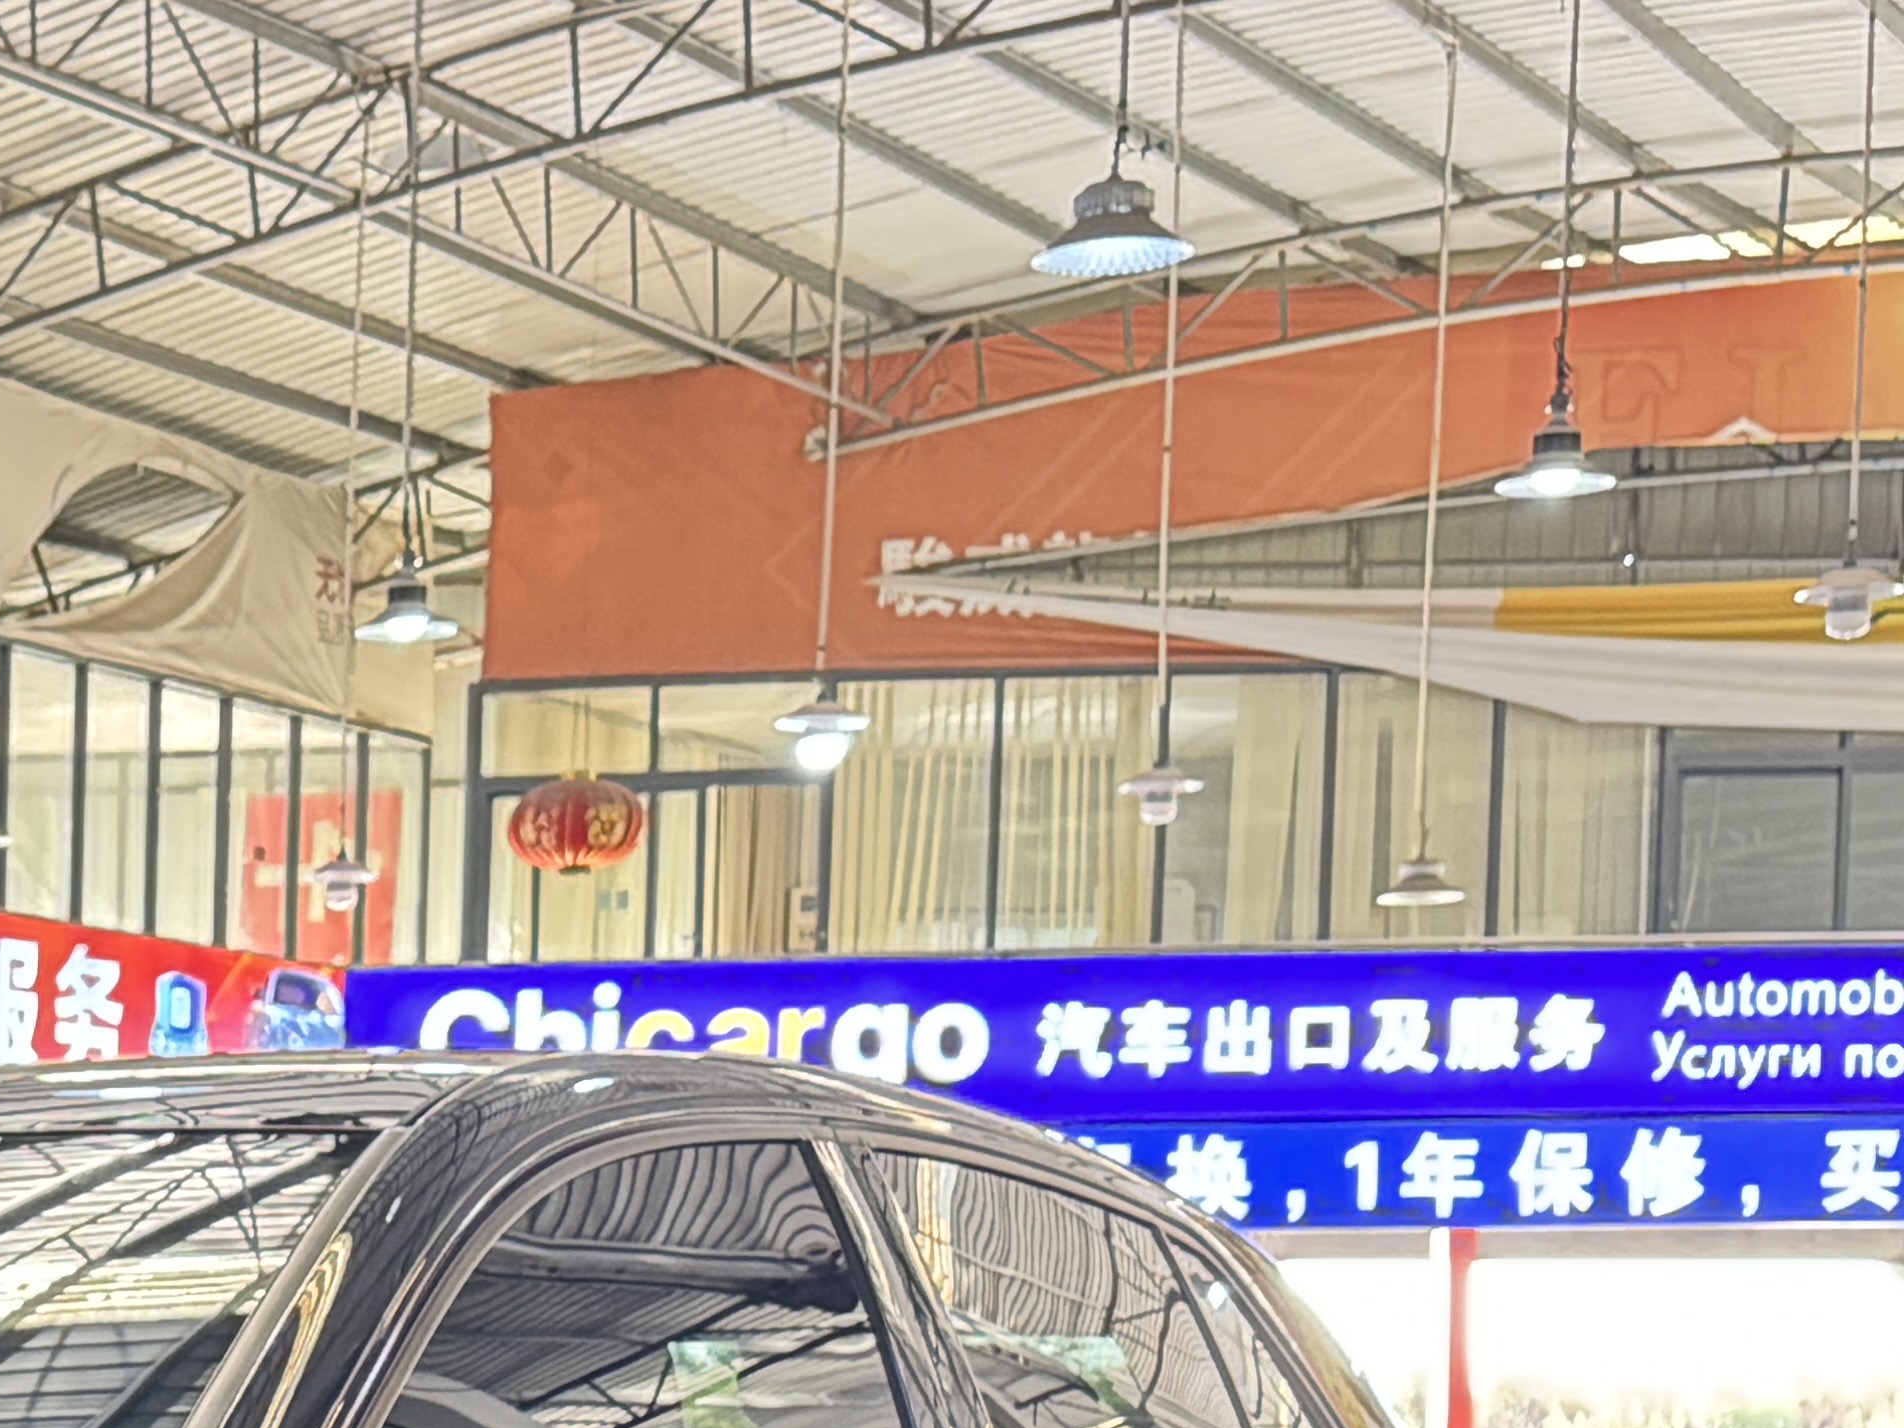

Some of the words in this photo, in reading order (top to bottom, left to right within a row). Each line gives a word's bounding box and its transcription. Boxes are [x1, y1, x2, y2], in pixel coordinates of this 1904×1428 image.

[1660, 968, 1904, 1018] Automob
[419, 980, 990, 1085] Chicargo
[1036, 993, 1606, 1079] 汽车出口及服务
[1651, 1030, 1822, 1091] Услуги
